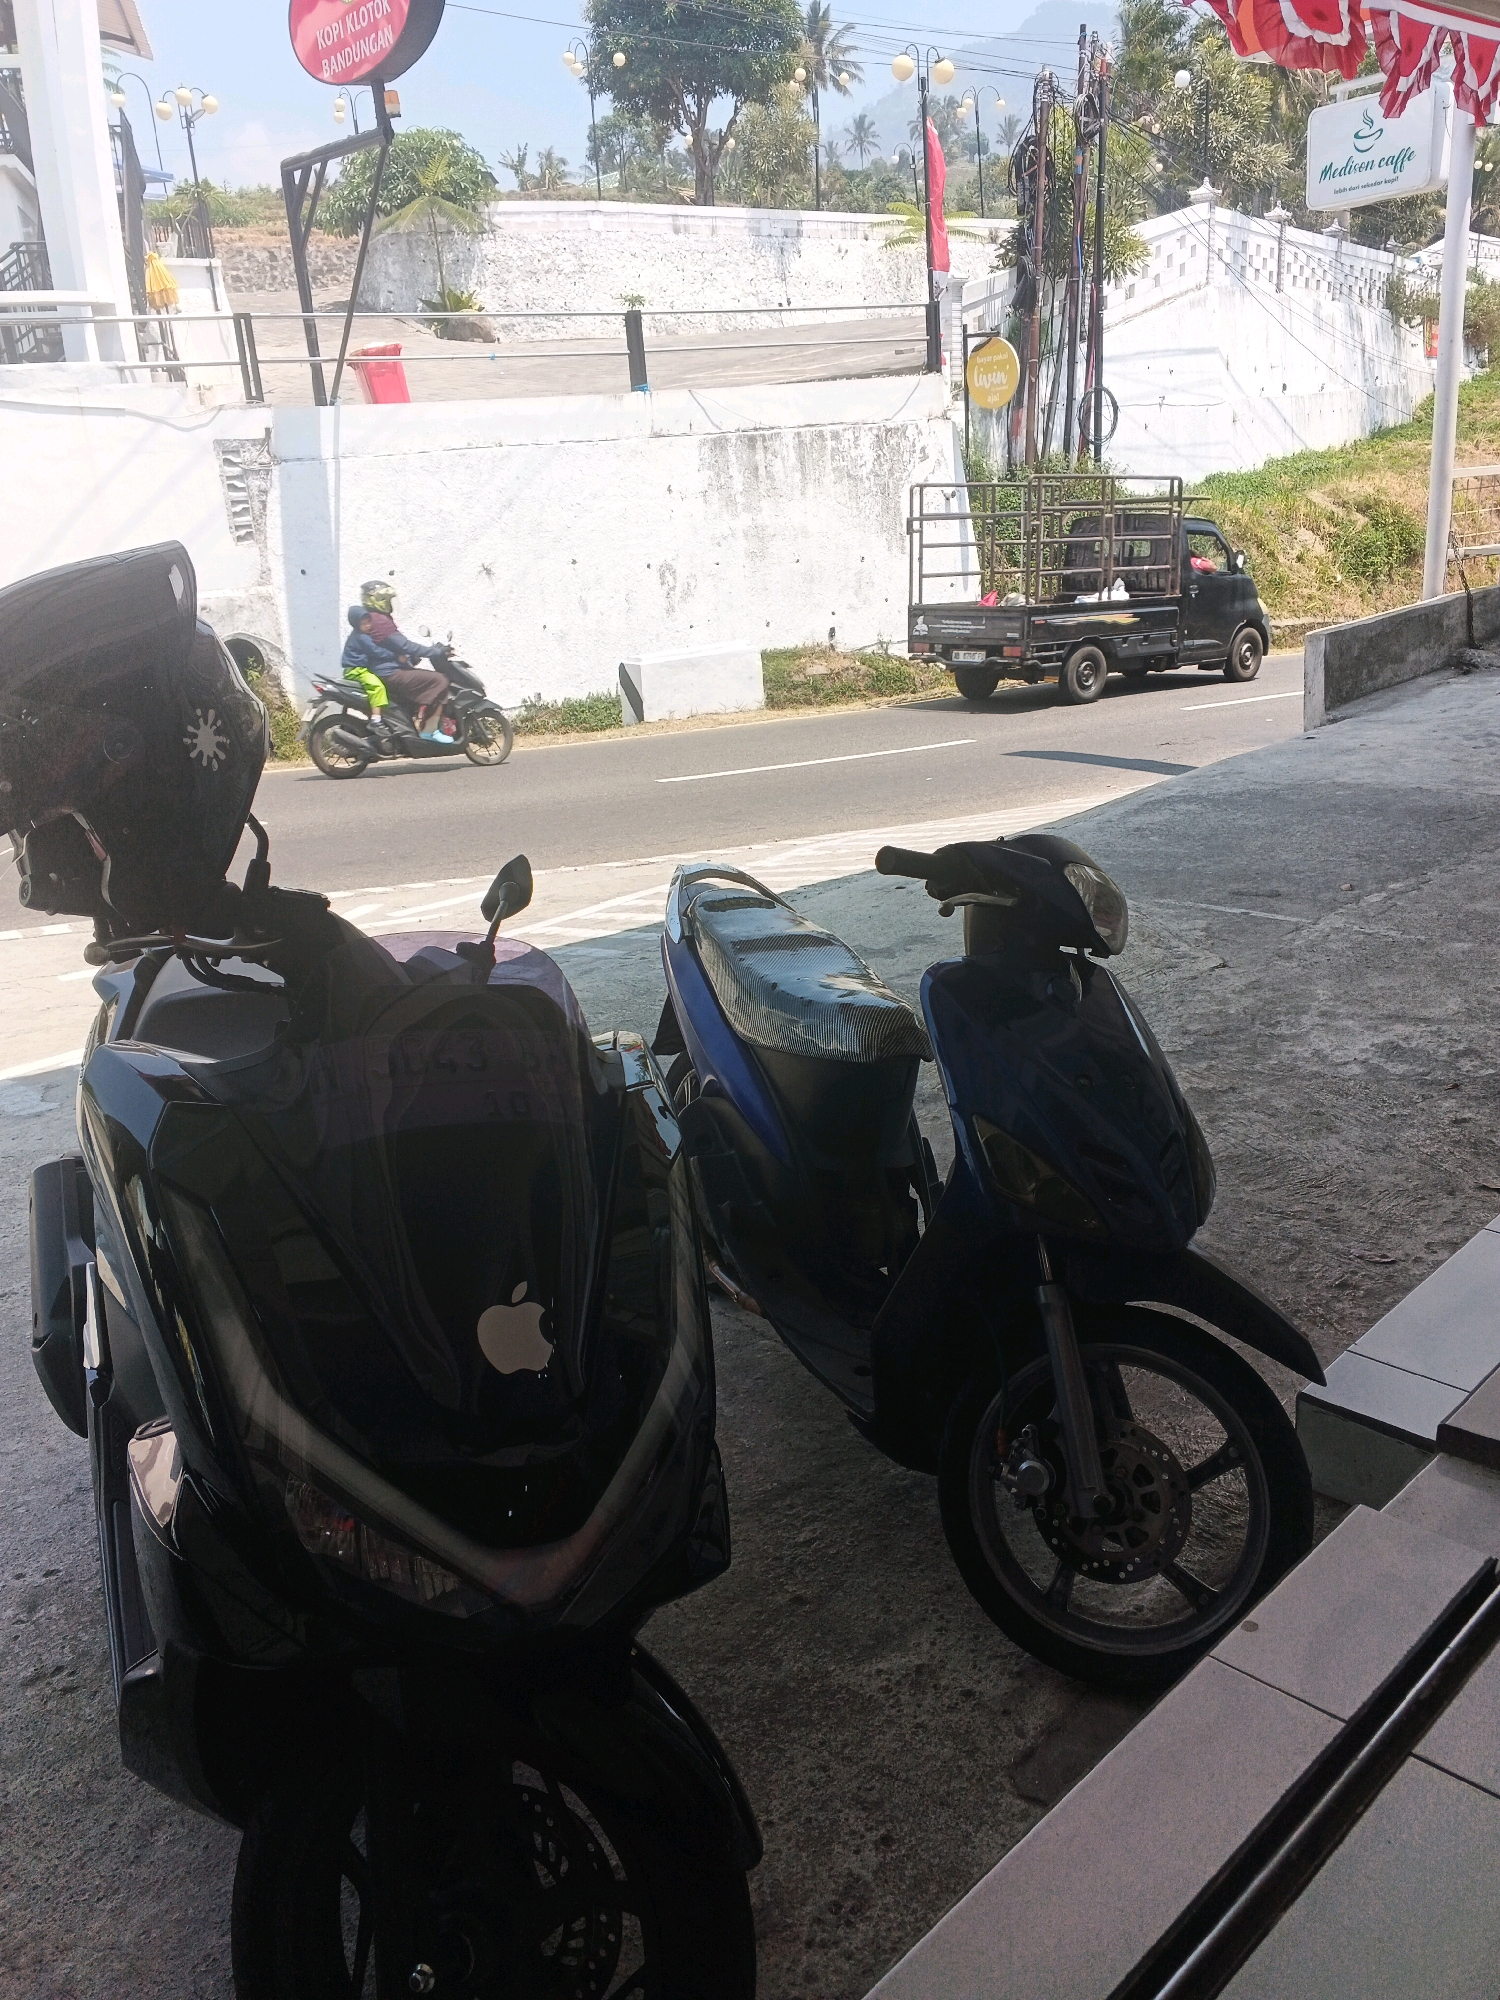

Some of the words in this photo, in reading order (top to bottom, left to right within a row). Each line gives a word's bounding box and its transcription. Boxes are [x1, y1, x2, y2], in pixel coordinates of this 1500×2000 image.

[316, 18, 345, 51] KOPI
[345, 0, 392, 35] KLOTOK
[321, 24, 394, 79] BANDUNGAN
[1319, 155, 1376, 184] Medison
[1378, 146, 1417, 175] caffe
[1333, 187, 1348, 195] lebih
[1348, 183, 1360, 192] dari
[1360, 179, 1384, 189] sekedar
[976, 355, 993, 364] bayar
